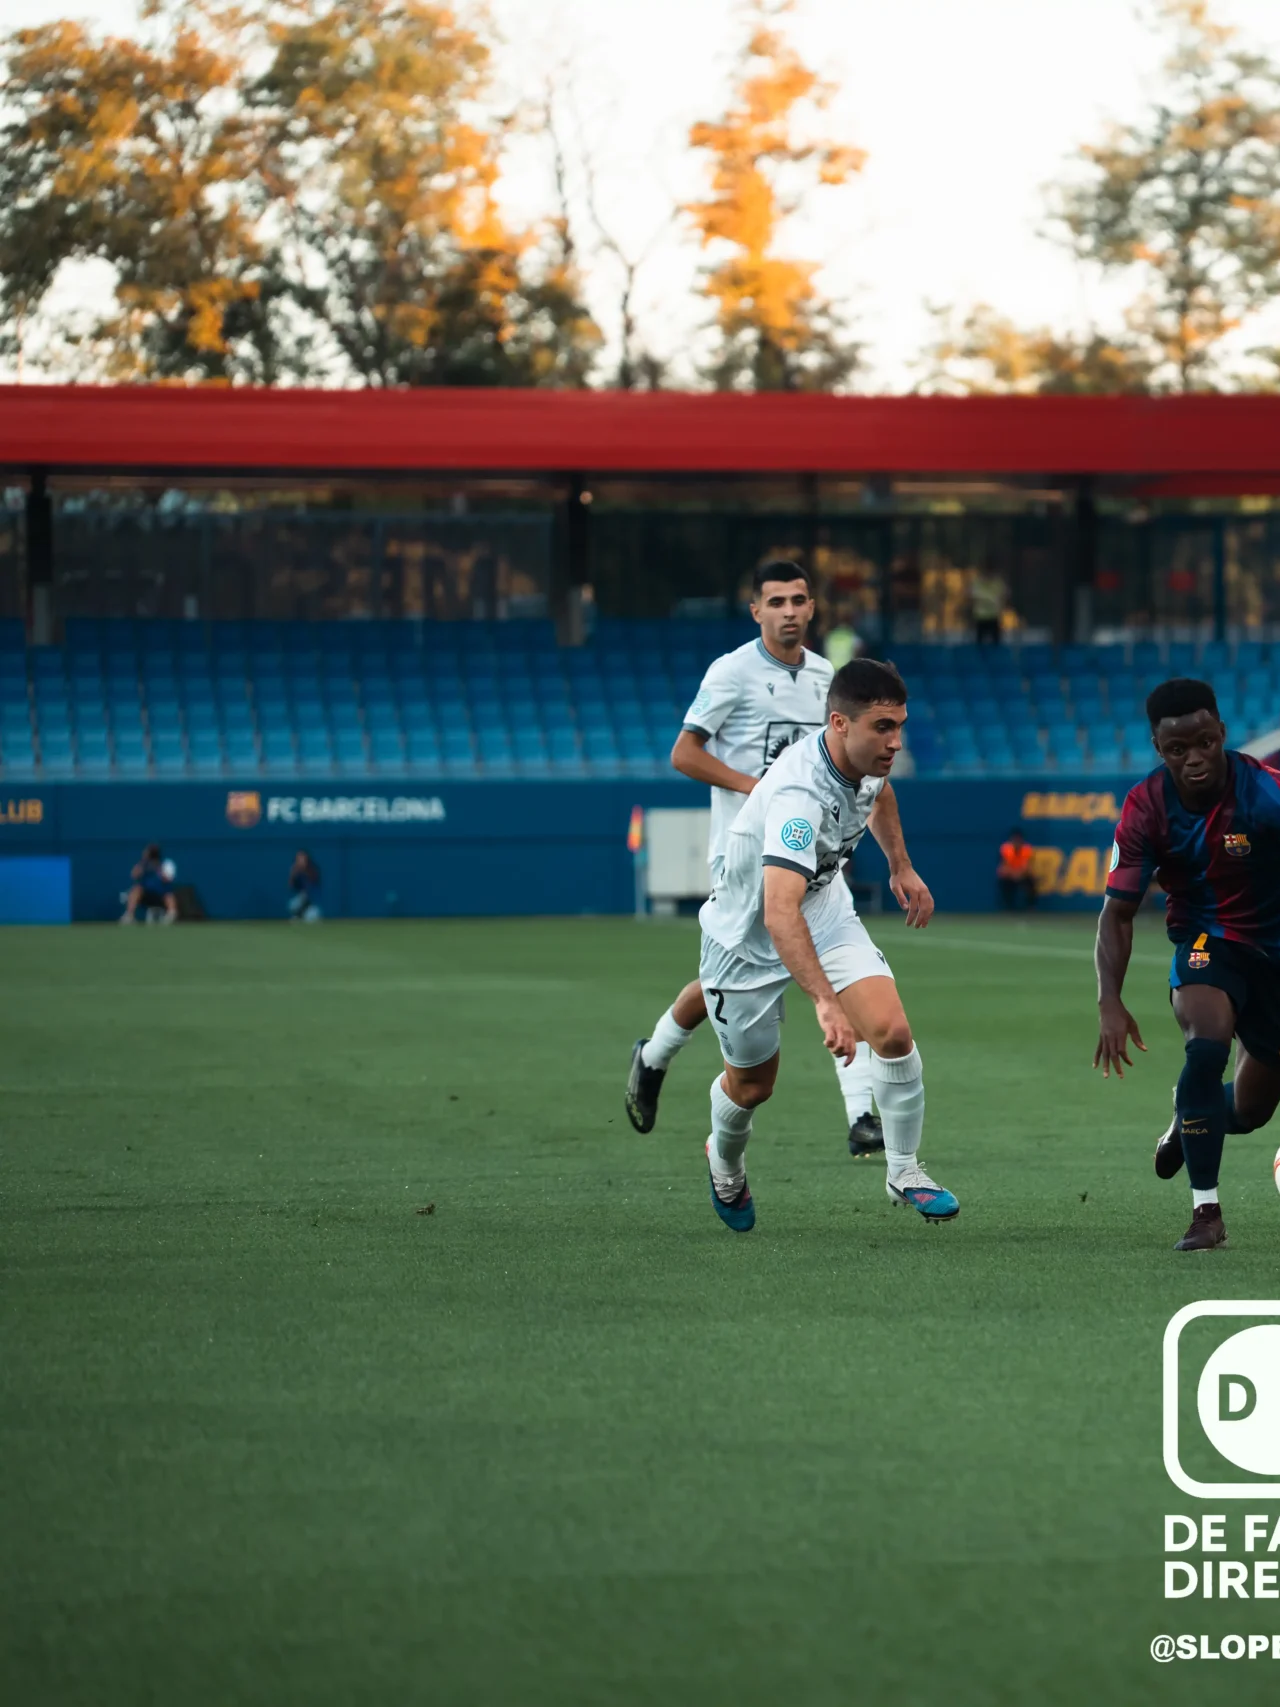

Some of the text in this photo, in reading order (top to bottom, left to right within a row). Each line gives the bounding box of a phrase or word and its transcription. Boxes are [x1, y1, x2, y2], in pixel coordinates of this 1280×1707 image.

[267, 797, 446, 823] FC BARCELONA
[708, 988, 728, 1025] 2
